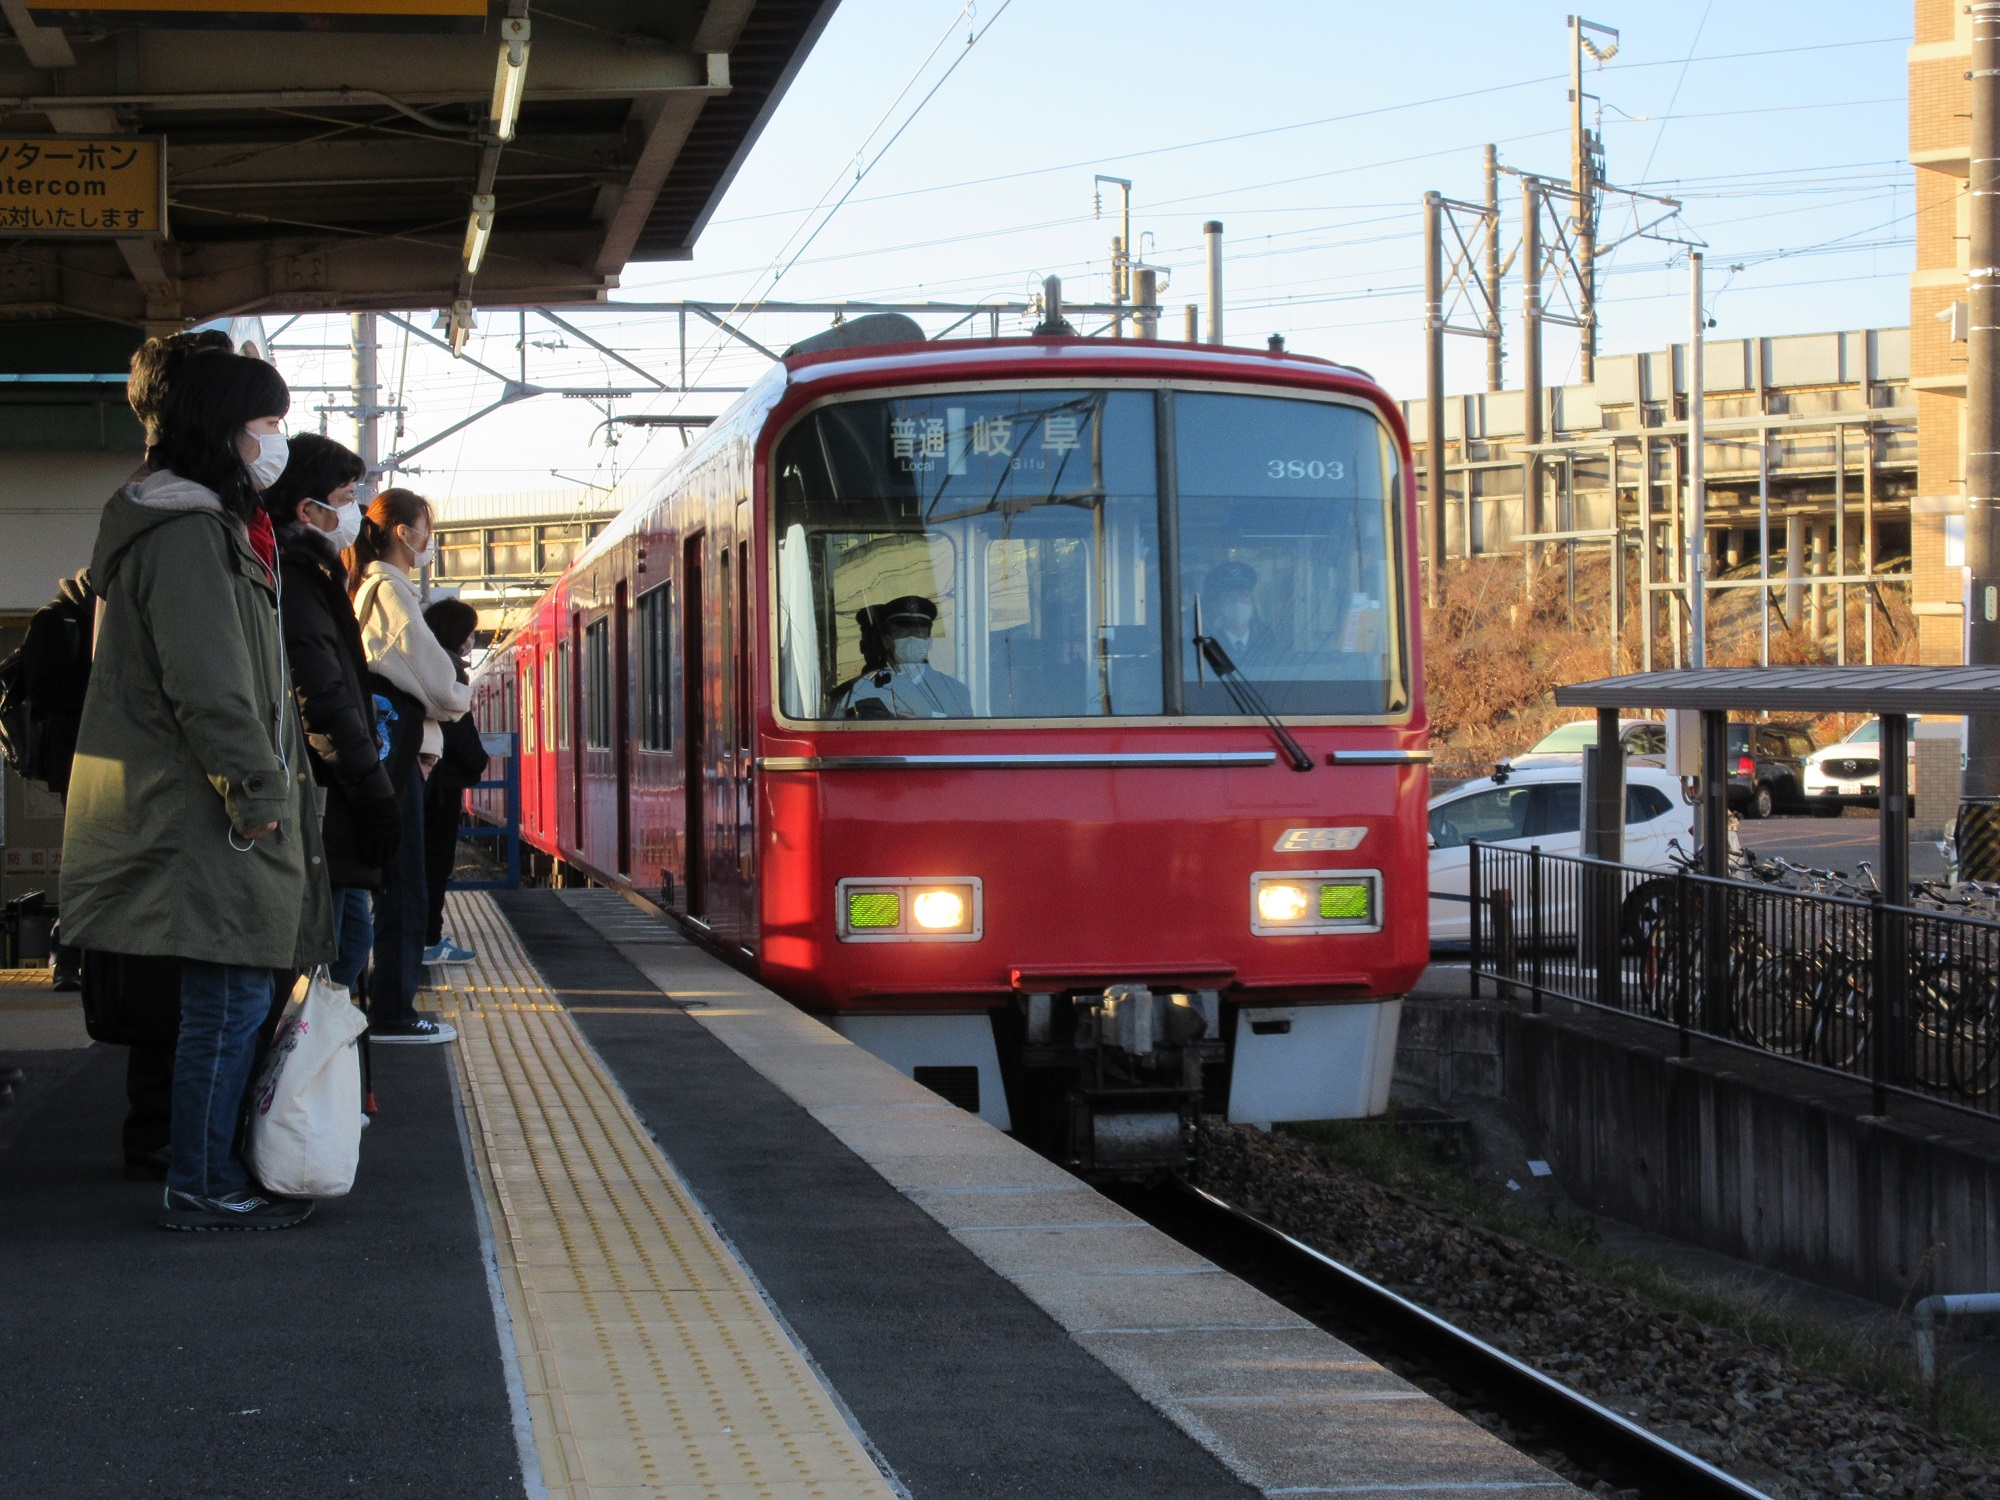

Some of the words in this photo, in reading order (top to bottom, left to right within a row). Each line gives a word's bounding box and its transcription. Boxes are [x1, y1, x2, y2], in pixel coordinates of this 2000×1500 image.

[0, 176, 106, 196] tercom
[890, 417, 945, 459] 普通
[972, 415, 1081, 457] 岐阜
[901, 460, 935, 472] Local
[1010, 457, 1045, 470] Gifu
[1267, 459, 1345, 480] 3803
